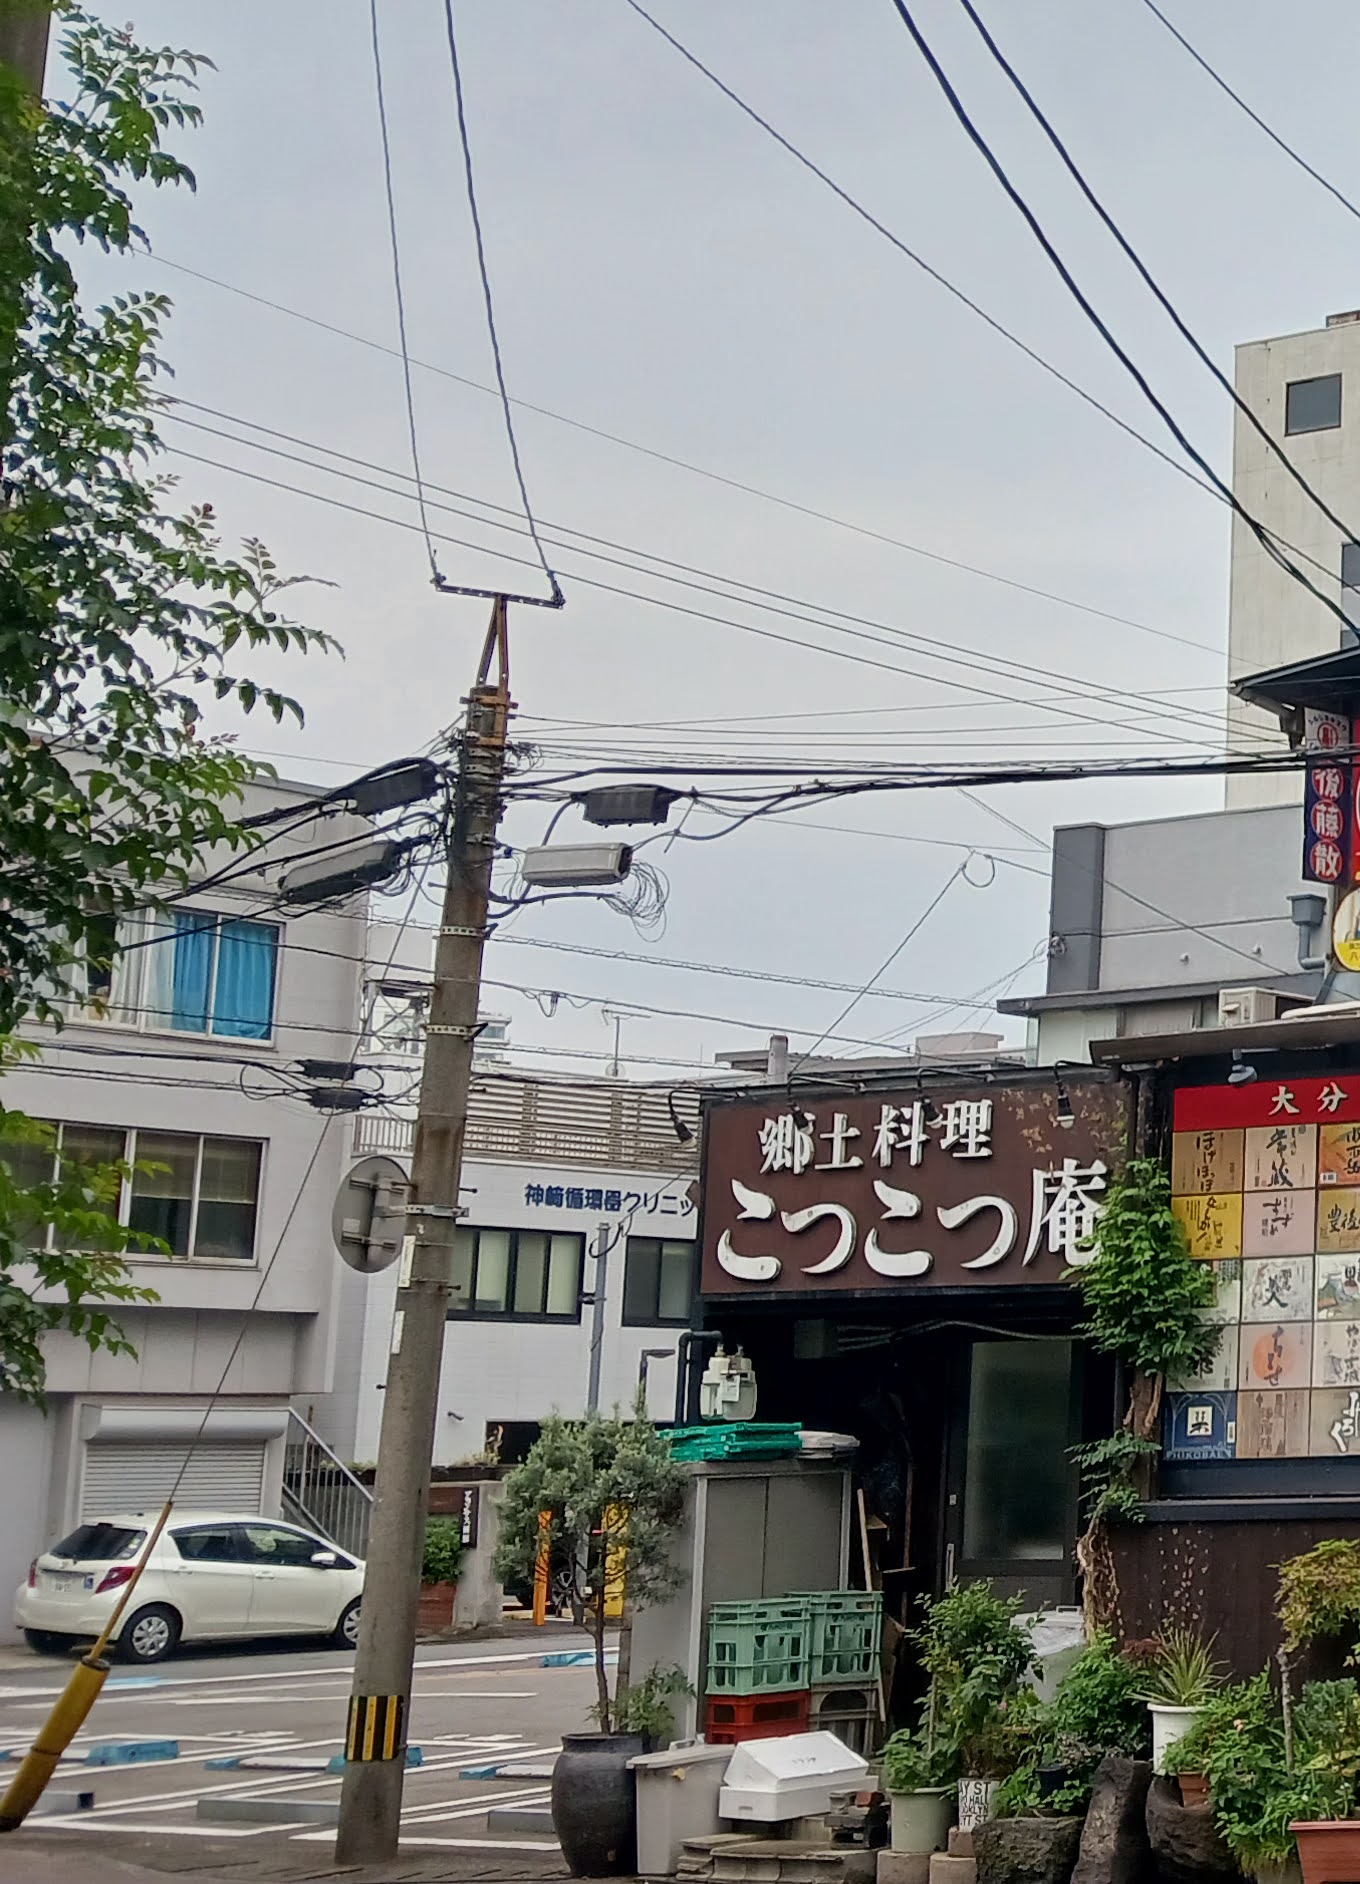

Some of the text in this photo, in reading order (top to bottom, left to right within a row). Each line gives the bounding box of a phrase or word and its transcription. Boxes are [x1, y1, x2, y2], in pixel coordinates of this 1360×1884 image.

[1316, 768, 1339, 879] 後藤散
[758, 1098, 994, 1176] 郷土料理
[716, 1158, 1107, 1281] こつこつ庵
